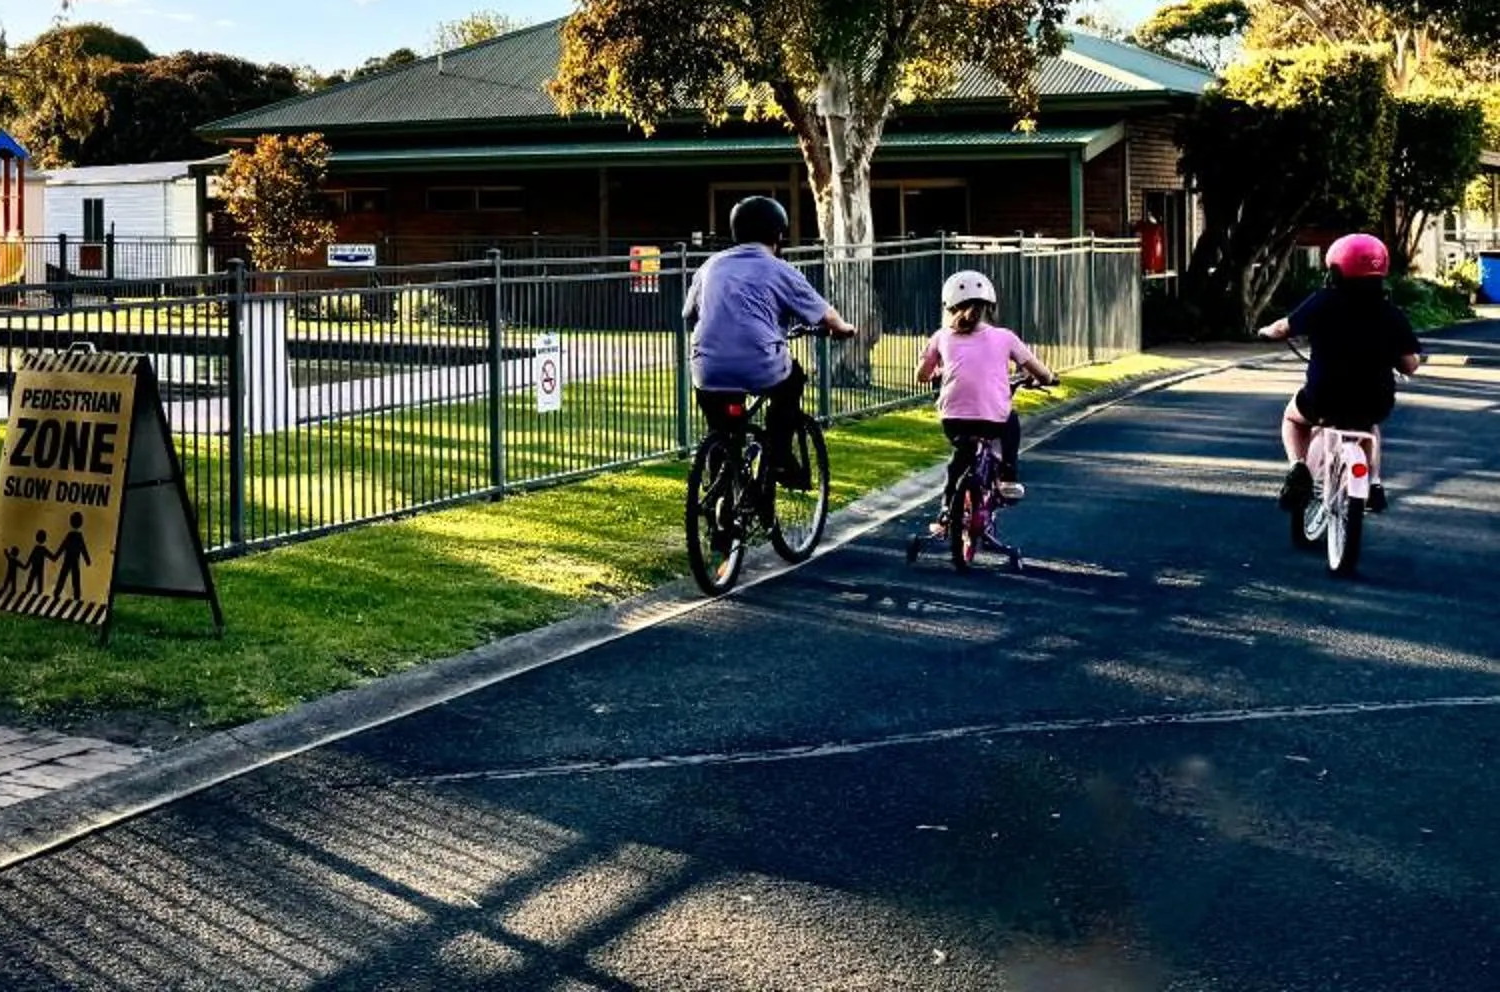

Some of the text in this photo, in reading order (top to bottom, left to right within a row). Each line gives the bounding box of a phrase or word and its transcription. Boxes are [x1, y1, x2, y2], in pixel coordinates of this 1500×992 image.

[21, 388, 122, 414] PEDESTRIAN
[9, 417, 118, 475] ZONE
[4, 475, 111, 507] SLOW DOWN
